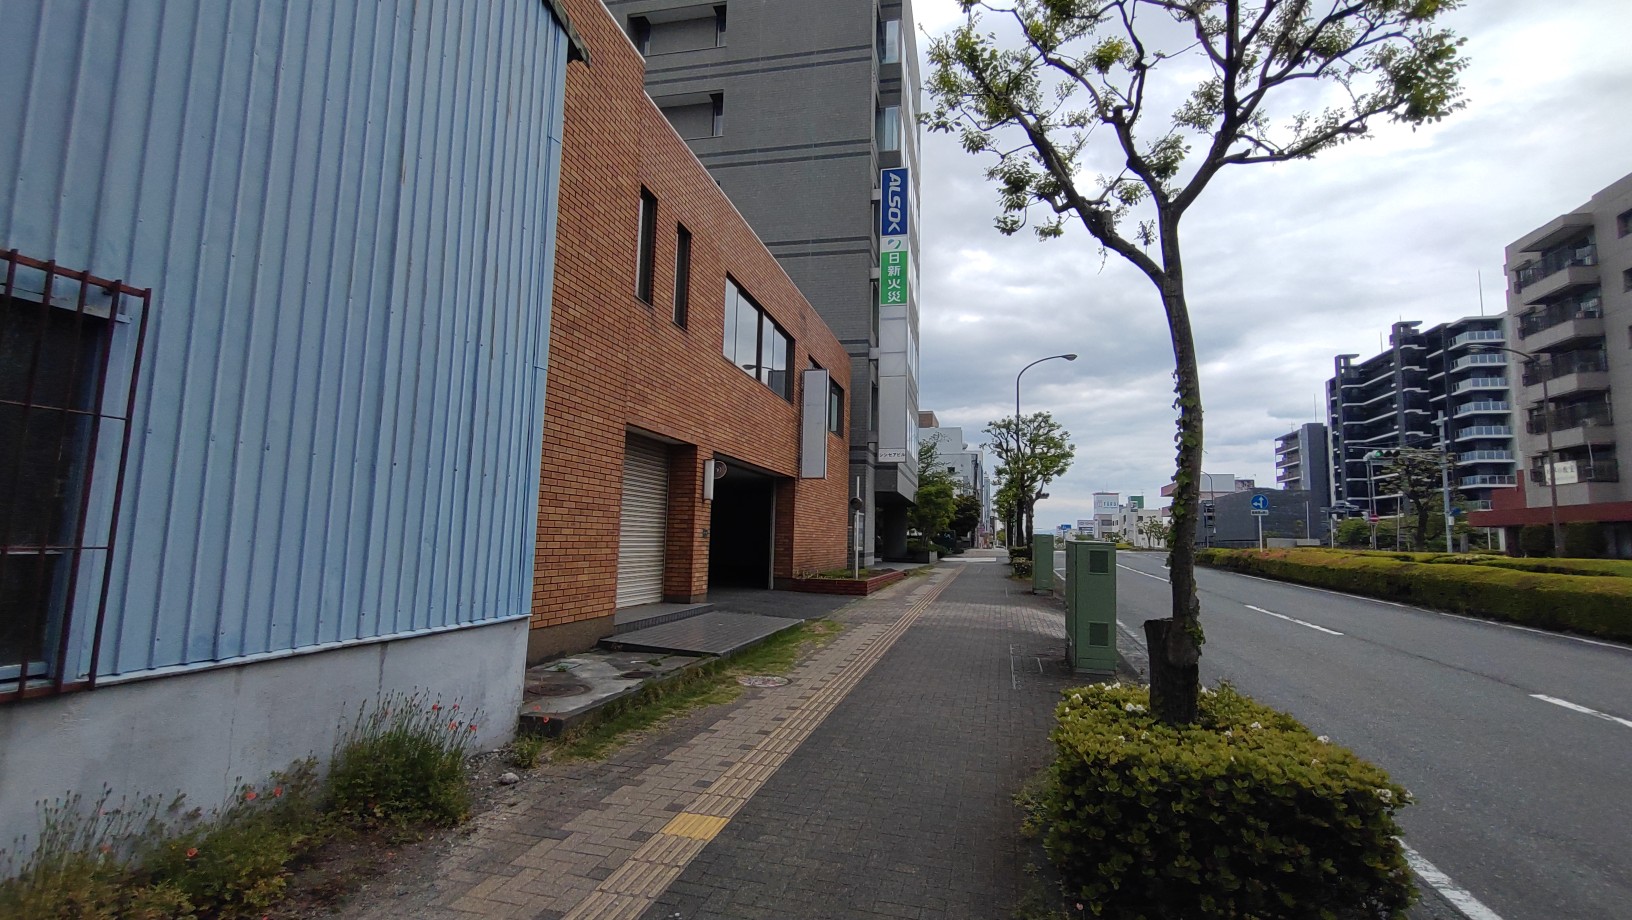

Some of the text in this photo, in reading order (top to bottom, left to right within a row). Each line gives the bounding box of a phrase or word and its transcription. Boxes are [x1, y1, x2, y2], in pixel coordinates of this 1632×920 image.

[887, 172, 902, 233] ALSOK
[887, 252, 901, 303] 日新火災
